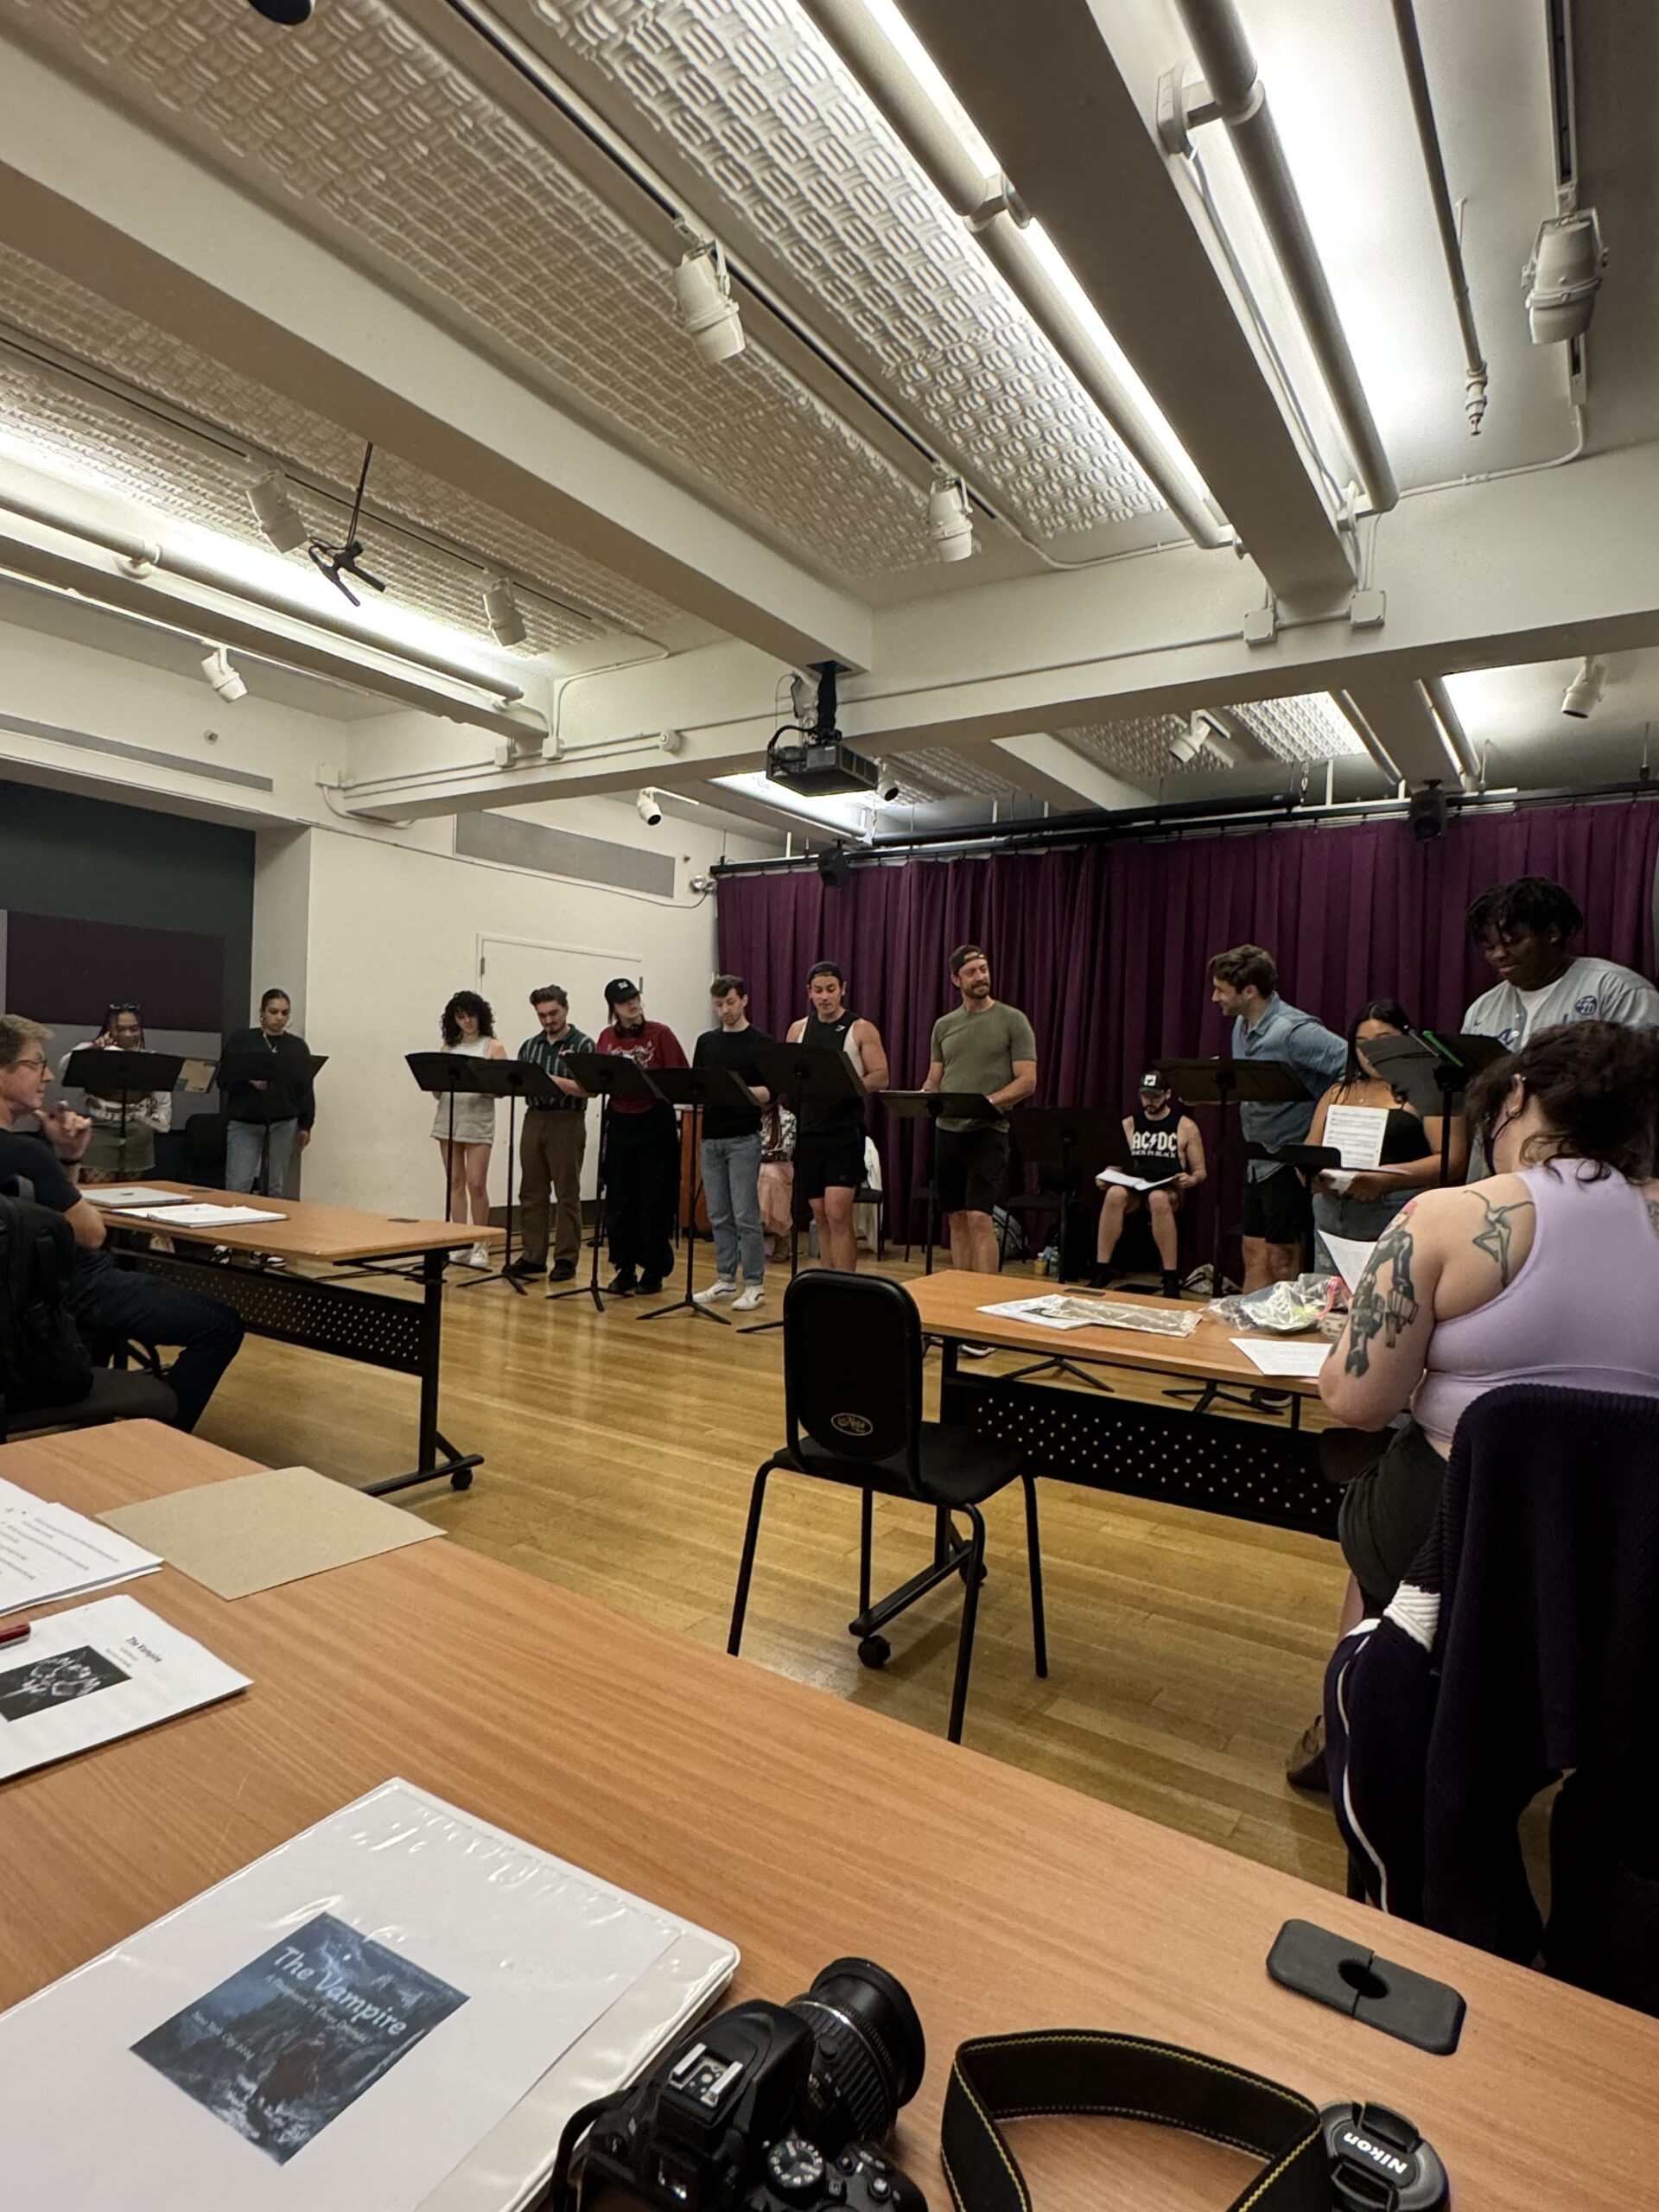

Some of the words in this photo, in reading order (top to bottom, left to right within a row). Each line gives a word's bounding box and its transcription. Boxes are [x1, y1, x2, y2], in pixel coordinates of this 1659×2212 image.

[274, 1946, 315, 1980] The
[315, 1970, 407, 2036] Vampire
[1343, 2132, 1408, 2175] Nikon
